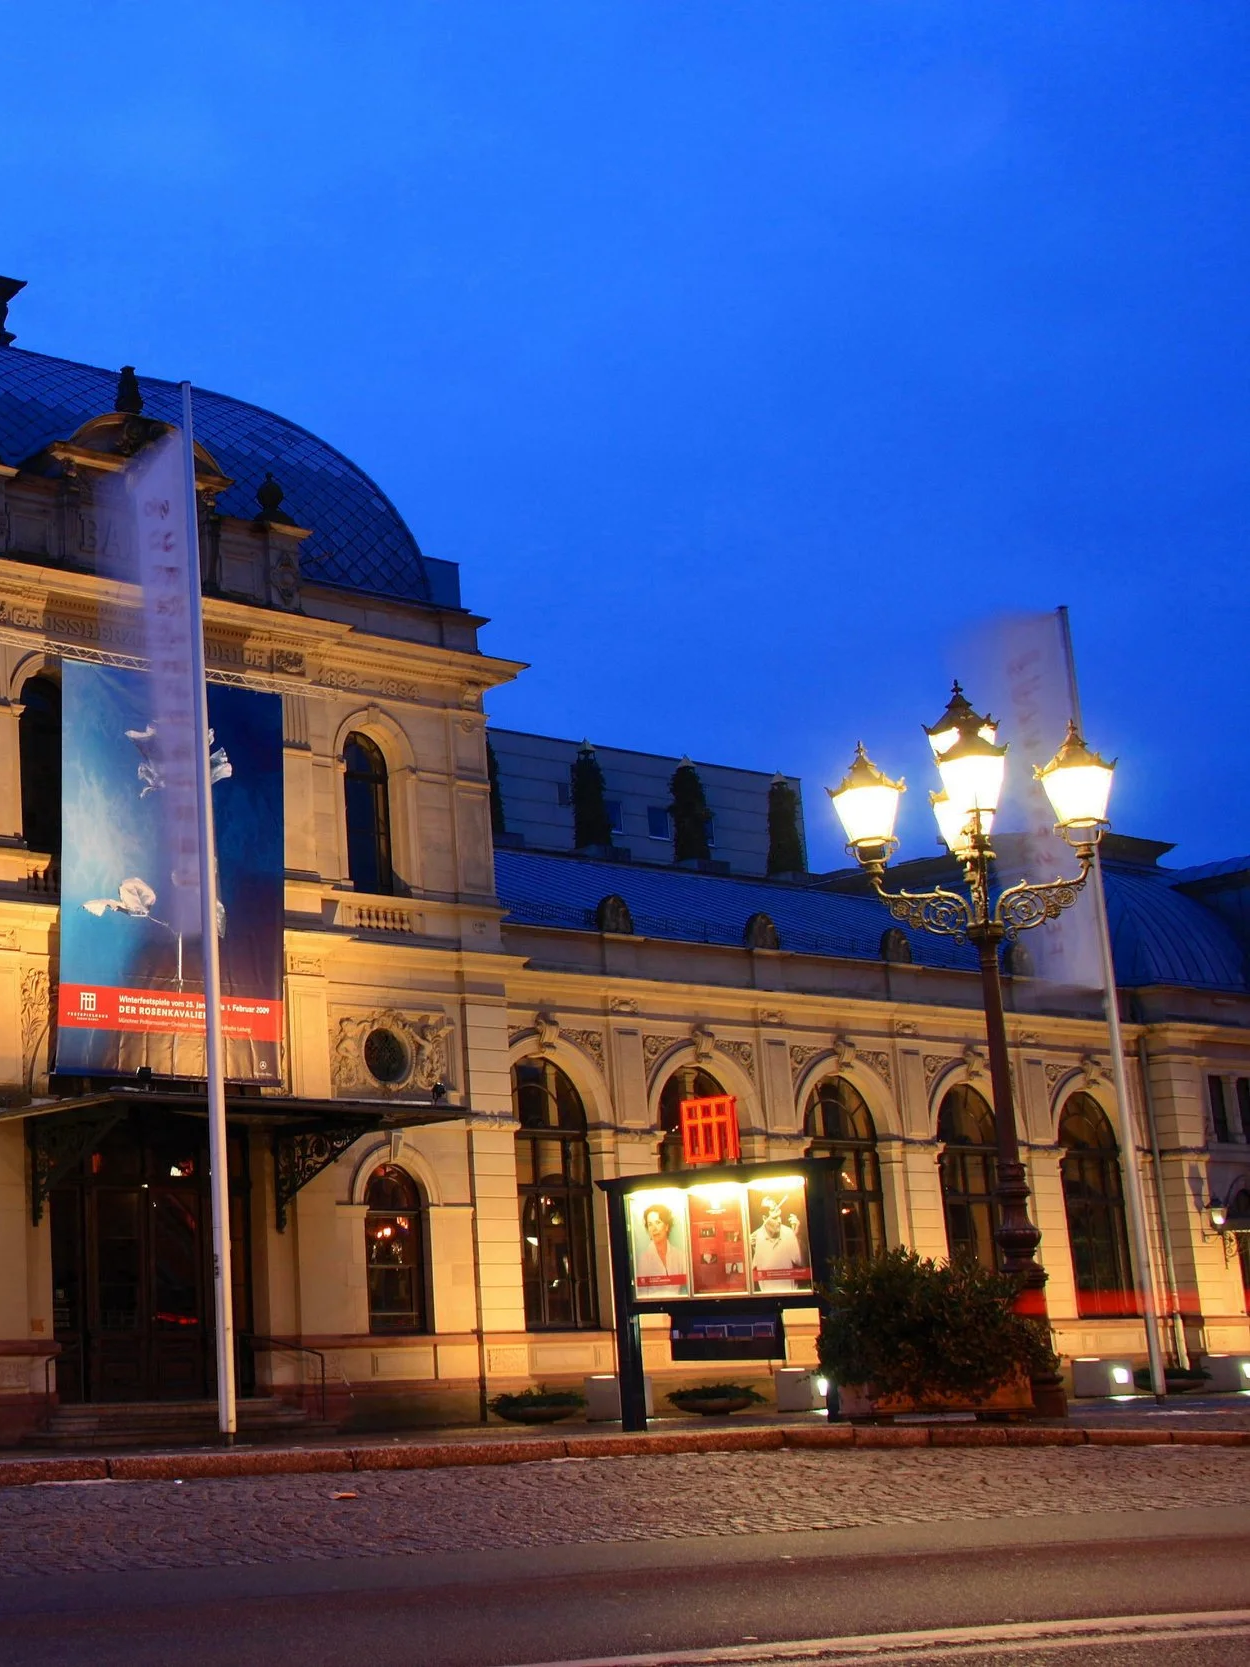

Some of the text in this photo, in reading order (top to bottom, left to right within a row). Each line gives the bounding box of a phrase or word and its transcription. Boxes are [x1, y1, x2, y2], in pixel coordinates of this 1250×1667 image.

[118, 1005, 136, 1014] DER
[171, 1000, 185, 1008] vom
[196, 1002, 206, 1010] Jan
[232, 1004, 255, 1013] Februar
[256, 1006, 270, 1015] 2009
